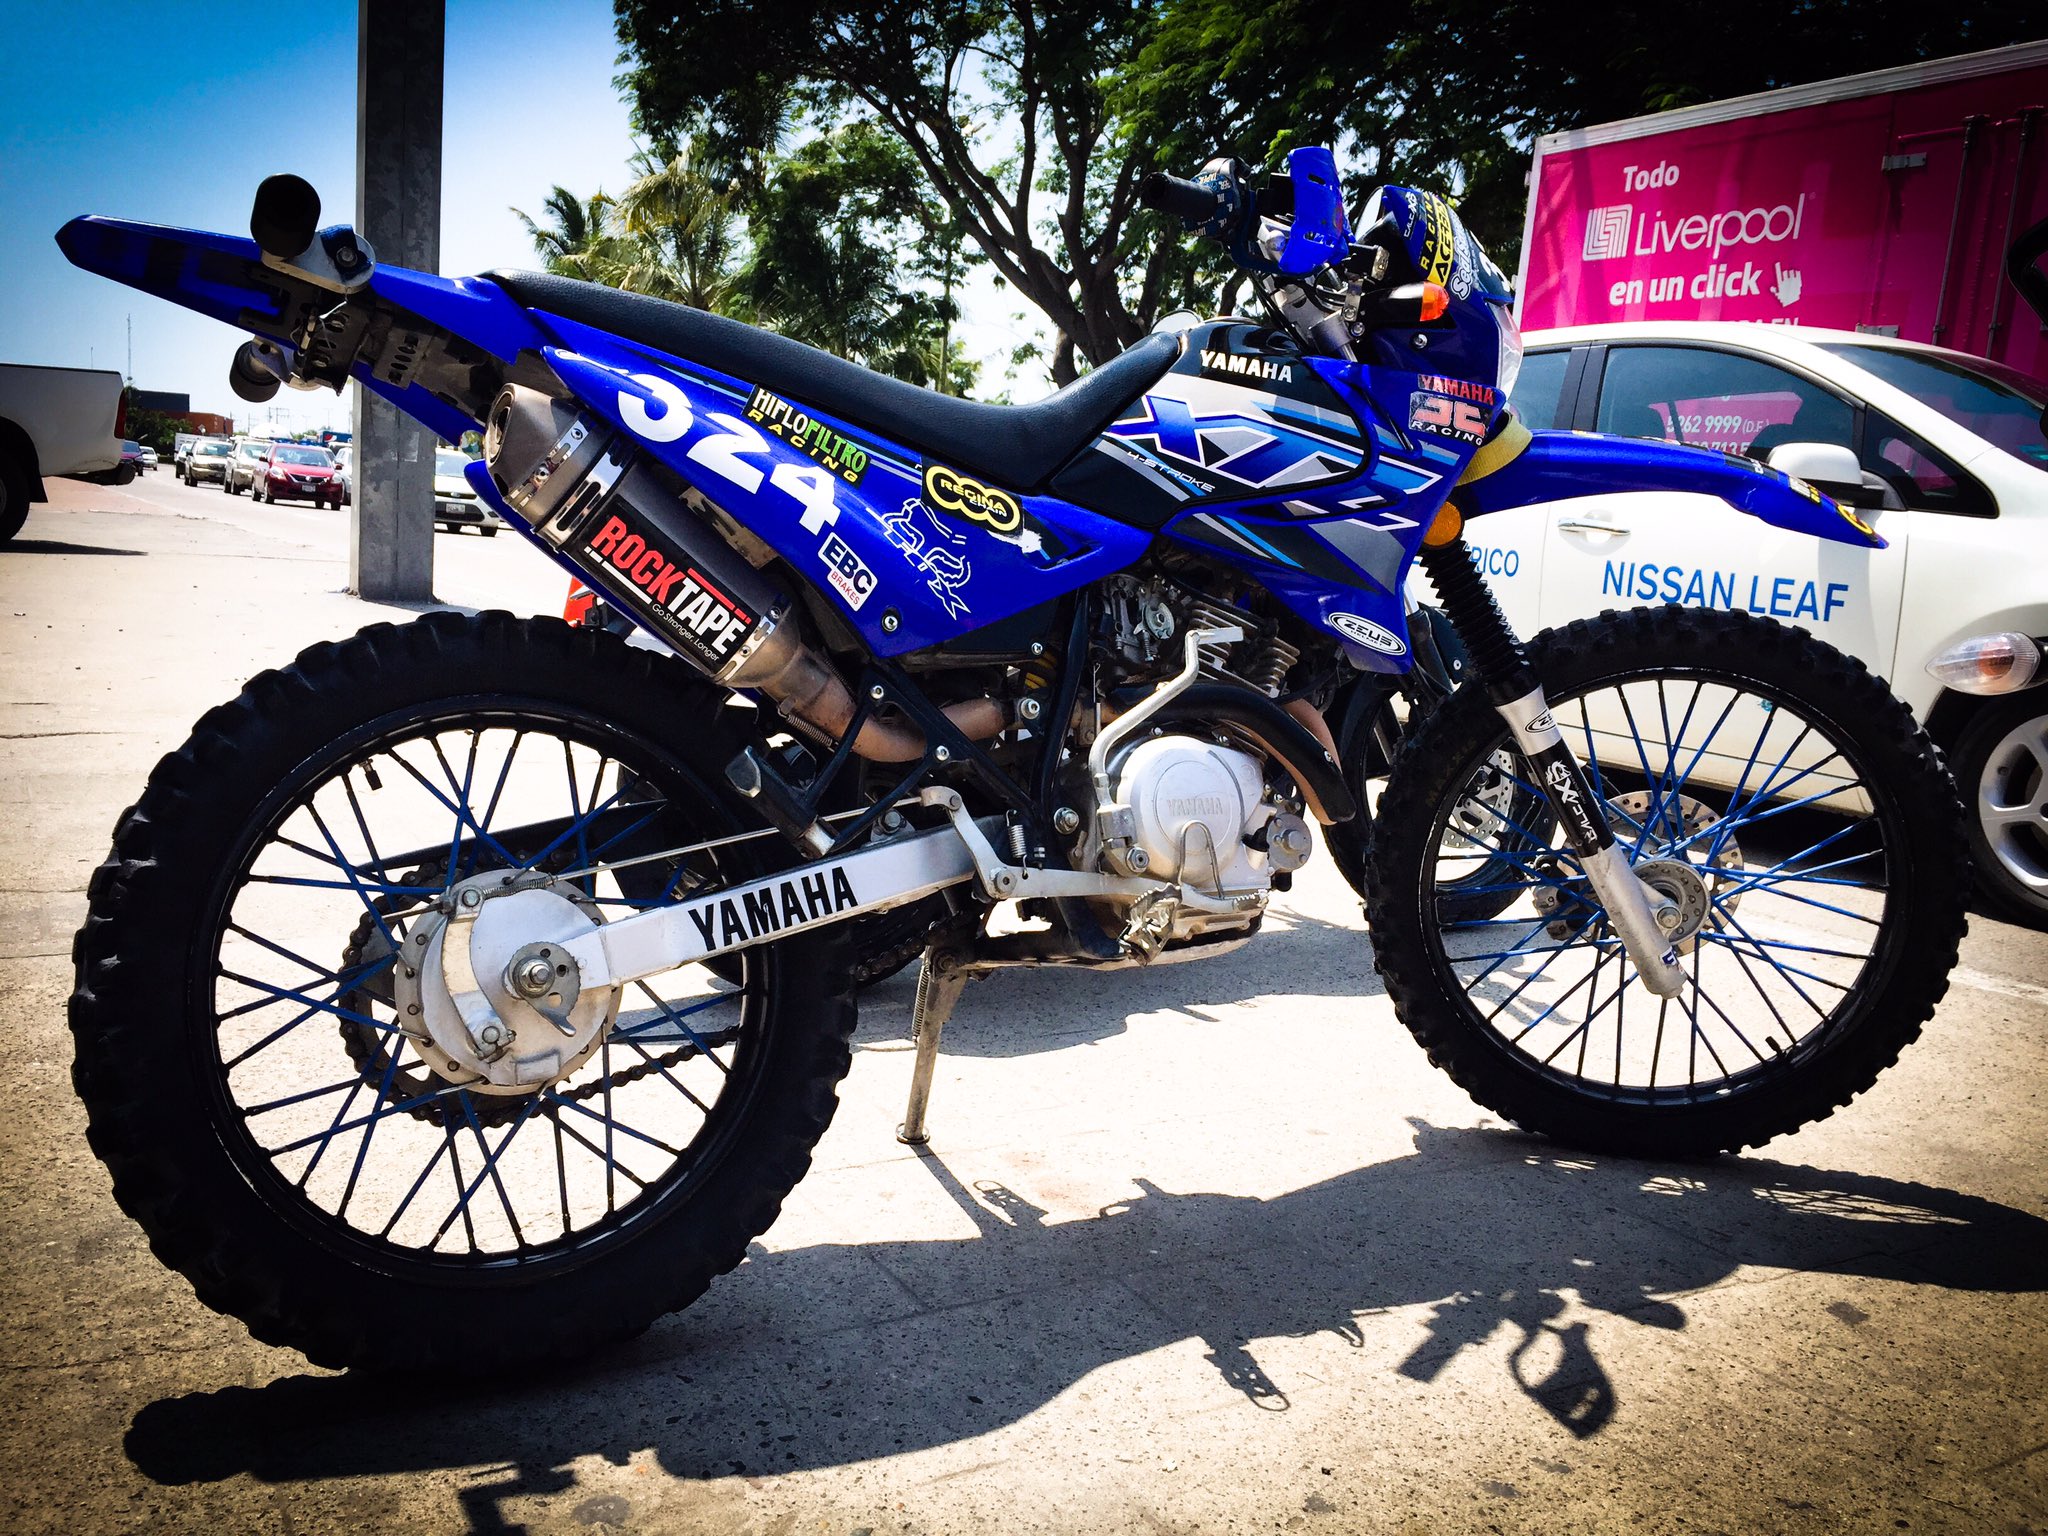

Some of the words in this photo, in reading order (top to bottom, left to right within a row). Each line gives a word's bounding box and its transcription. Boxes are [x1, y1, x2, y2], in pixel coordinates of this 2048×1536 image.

[1623, 160, 1680, 192] Todo
[1634, 193, 1805, 259] Liverpool
[1609, 279, 1643, 306] en
[1649, 274, 1685, 303] un
[1690, 262, 1763, 299] click
[1200, 349, 1293, 384] YAMAHA
[1421, 375, 1494, 406] YAMAHA
[751, 387, 867, 473] HIFLOFILTRO
[1411, 420, 1483, 446] RACING
[1705, 415, 1742, 434] 9999
[617, 371, 842, 536] 324
[747, 408, 859, 484] RACING
[1127, 451, 1216, 493] 4-STROKE
[940, 478, 1007, 513] REGINA
[823, 536, 873, 595] EBC
[1463, 542, 1520, 577] RICO
[831, 571, 860, 605] BRAKES
[1602, 559, 1736, 609] NISSAN
[1748, 575, 1849, 622] LEAF
[652, 603, 665, 616] Go
[663, 612, 695, 643] Stronger,
[693, 638, 720, 662] Longer
[1344, 619, 1393, 647] ZEUS
[1167, 797, 1223, 817] YAMAHA
[687, 866, 859, 952] YAMAHA
